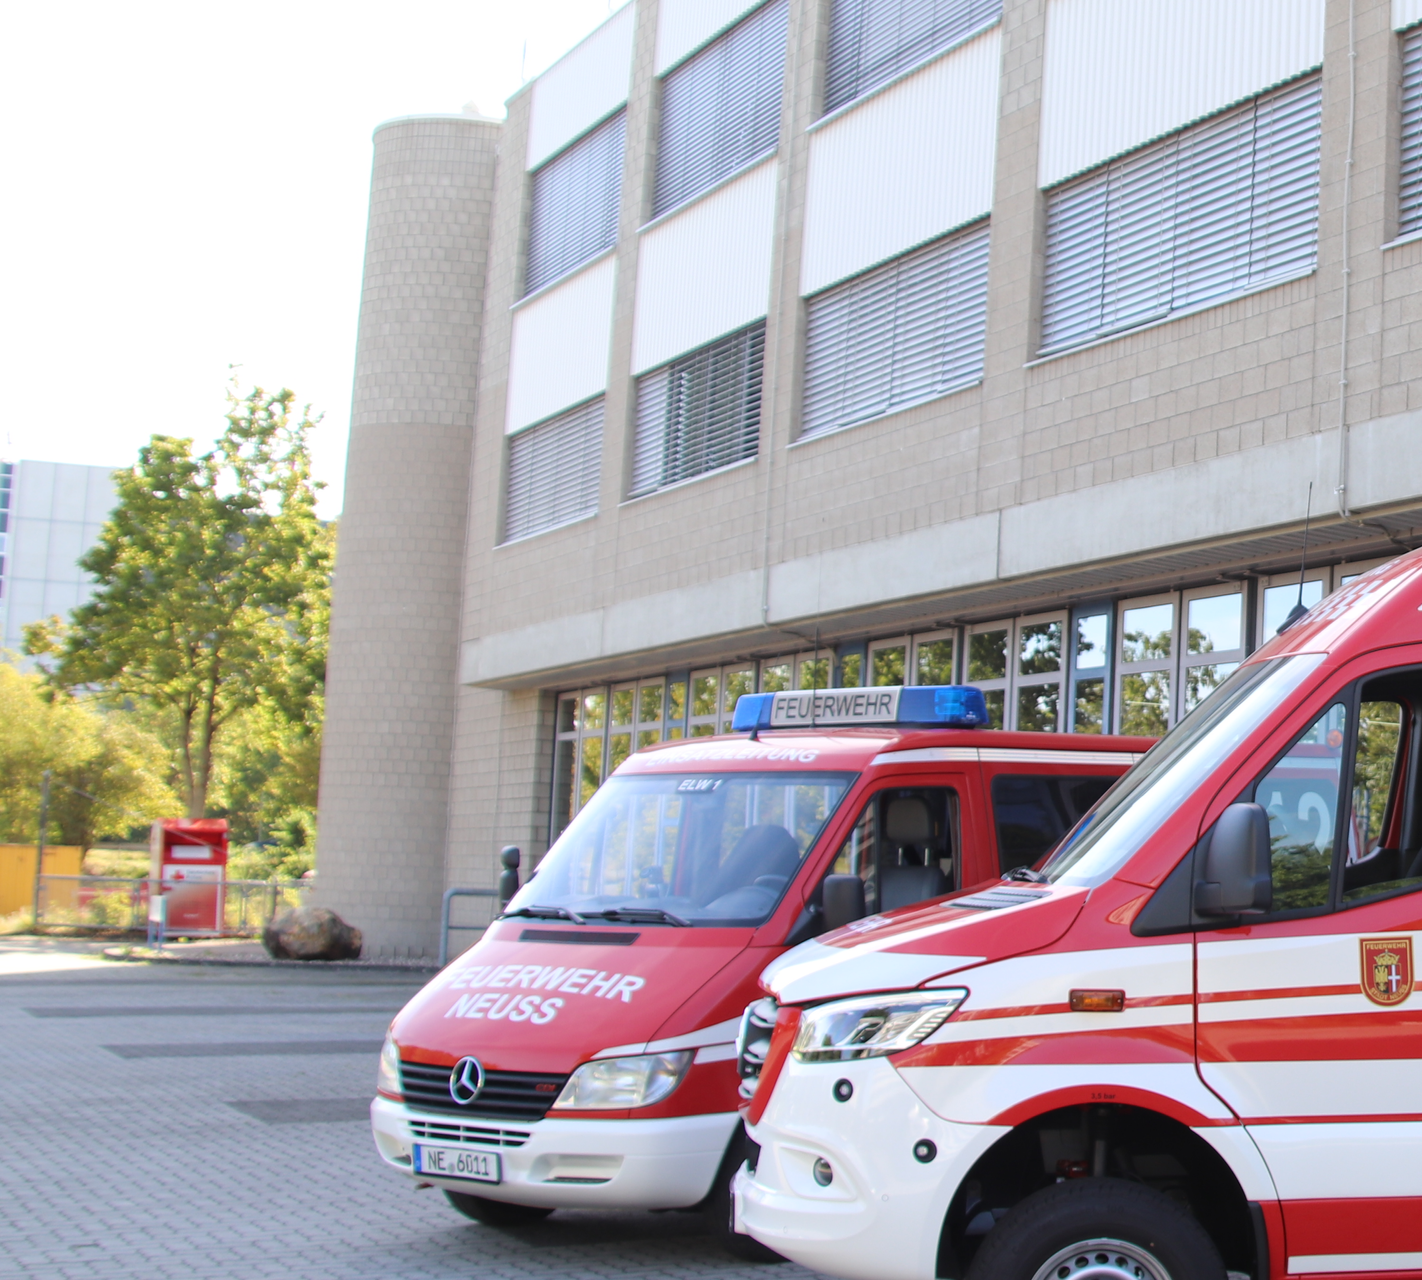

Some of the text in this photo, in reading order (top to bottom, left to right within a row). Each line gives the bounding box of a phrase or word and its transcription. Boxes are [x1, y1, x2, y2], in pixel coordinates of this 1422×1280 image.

[774, 693, 892, 719] FEUERWEHR
[645, 748, 820, 767] EINSATZLEITUNG
[678, 779, 723, 791] ELW 1
[1366, 942, 1406, 950] FEUERWEHR
[436, 964, 646, 1004] FEUERWEHR
[444, 993, 565, 1025] NEUSS
[1103, 1092, 1116, 1100] bar
[427, 1150, 489, 1176] NE 6011
